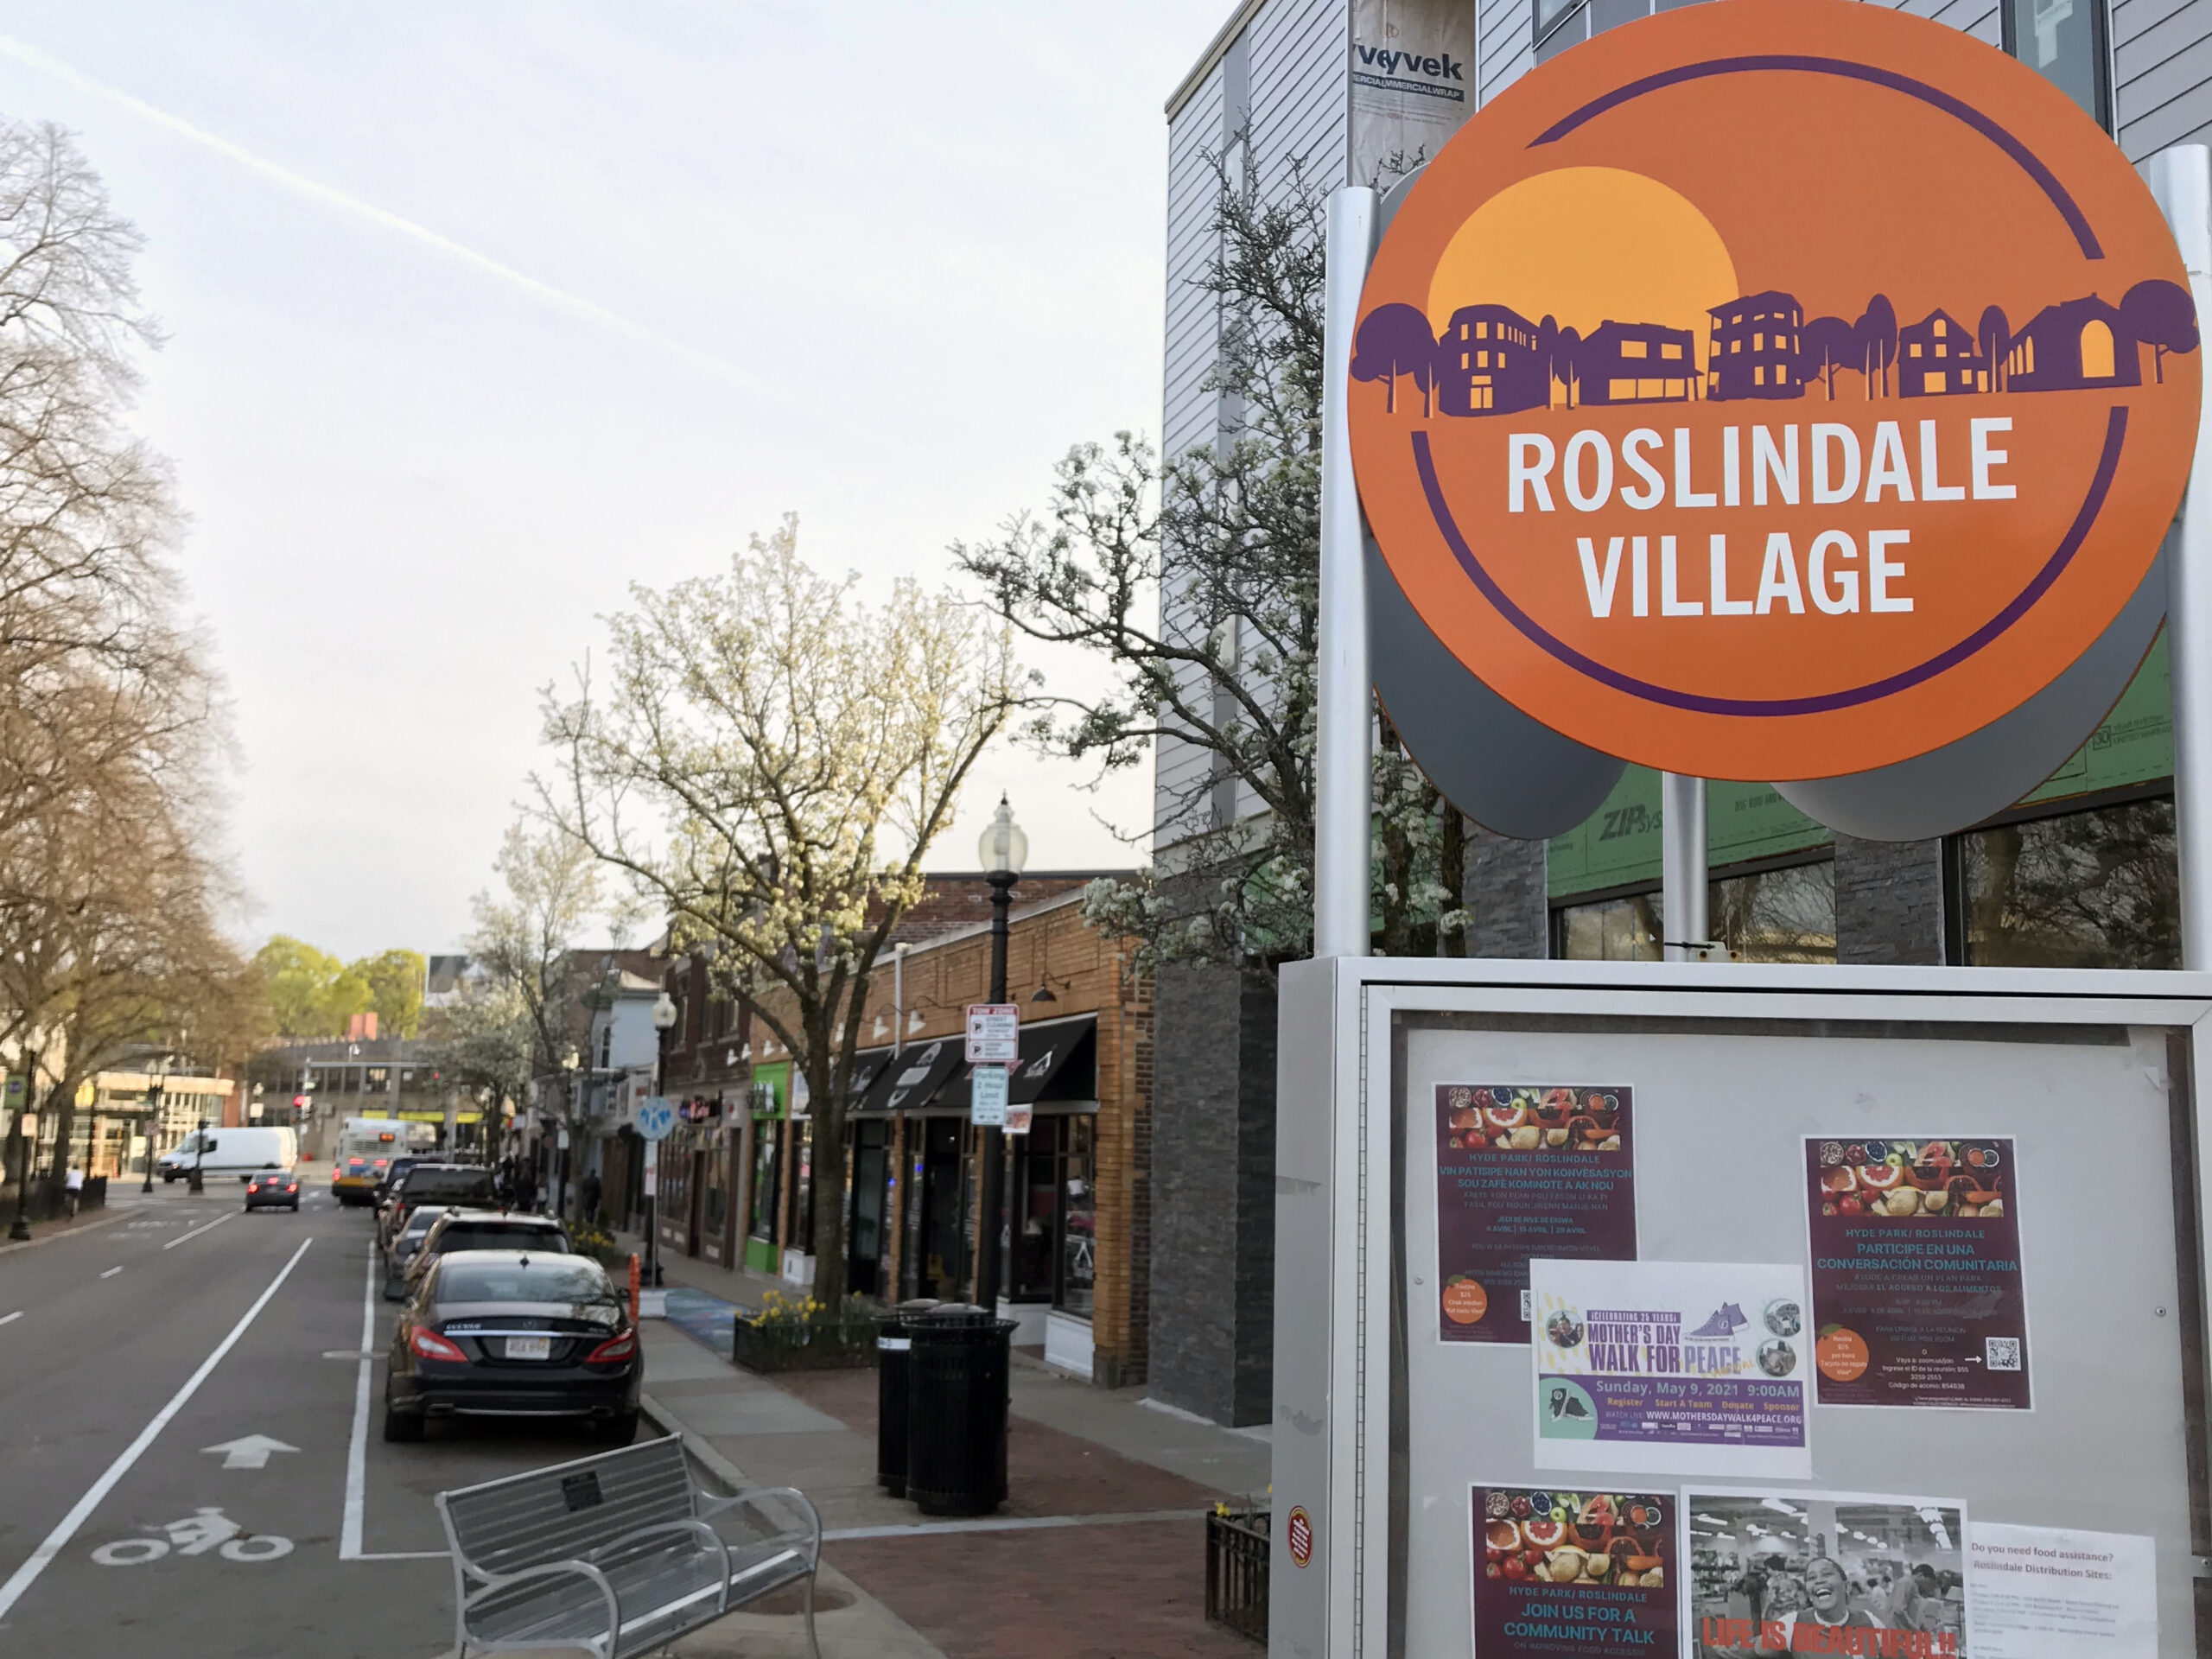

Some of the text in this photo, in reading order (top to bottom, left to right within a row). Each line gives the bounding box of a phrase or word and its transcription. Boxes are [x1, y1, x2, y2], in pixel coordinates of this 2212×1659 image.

[1508, 416, 2018, 512] ROSLINDALE
[1576, 528, 1914, 619] VILLAGE
[1469, 1154, 1497, 1162] HYDE
[1535, 1154, 1600, 1164] ROSLINDALE
[1440, 1166, 1455, 1176] VIN
[1459, 1166, 1503, 1176] PATISIPE
[1505, 1167, 1527, 1177] NAN
[1529, 1168, 1552, 1178] YON
[1458, 1179, 1479, 1188] SOU
[1509, 1179, 1563, 1190] KOMINOTE
[1565, 1181, 1573, 1190] A
[1575, 1181, 1589, 1191] AK
[1591, 1181, 1614, 1191] NOU
[1916, 1230, 1985, 1238] ROSLINDALE
[1858, 1243, 1975, 1255] PARTICIPE EN UNA
[1924, 1259, 2018, 1271] COMUNITARIA
[1641, 1313, 1649, 1322] 25
[1656, 1325, 1681, 1344] DAY
[1589, 1344, 1741, 1375] WALK FOR PEACE
[1596, 1381, 1800, 1397] Sunday, May 9, 2021 9:00AM
[1607, 1397, 1800, 1413] Register Start A Team Donate Sponsor
[1971, 1542, 2114, 1562] Do you need food assistance?
[1974, 1560, 2113, 1580] Roslindale Distribution Sites:
[1509, 1586, 1539, 1596] HYDE
[1579, 1591, 1648, 1603] ROSLINDALE
[1522, 1603, 1636, 1624] JOIN US FOR A
[1503, 1621, 1656, 1645] COMMUNITY TALK
[1702, 1617, 1754, 1649] LIFE
[1760, 1620, 1786, 1650] IS
